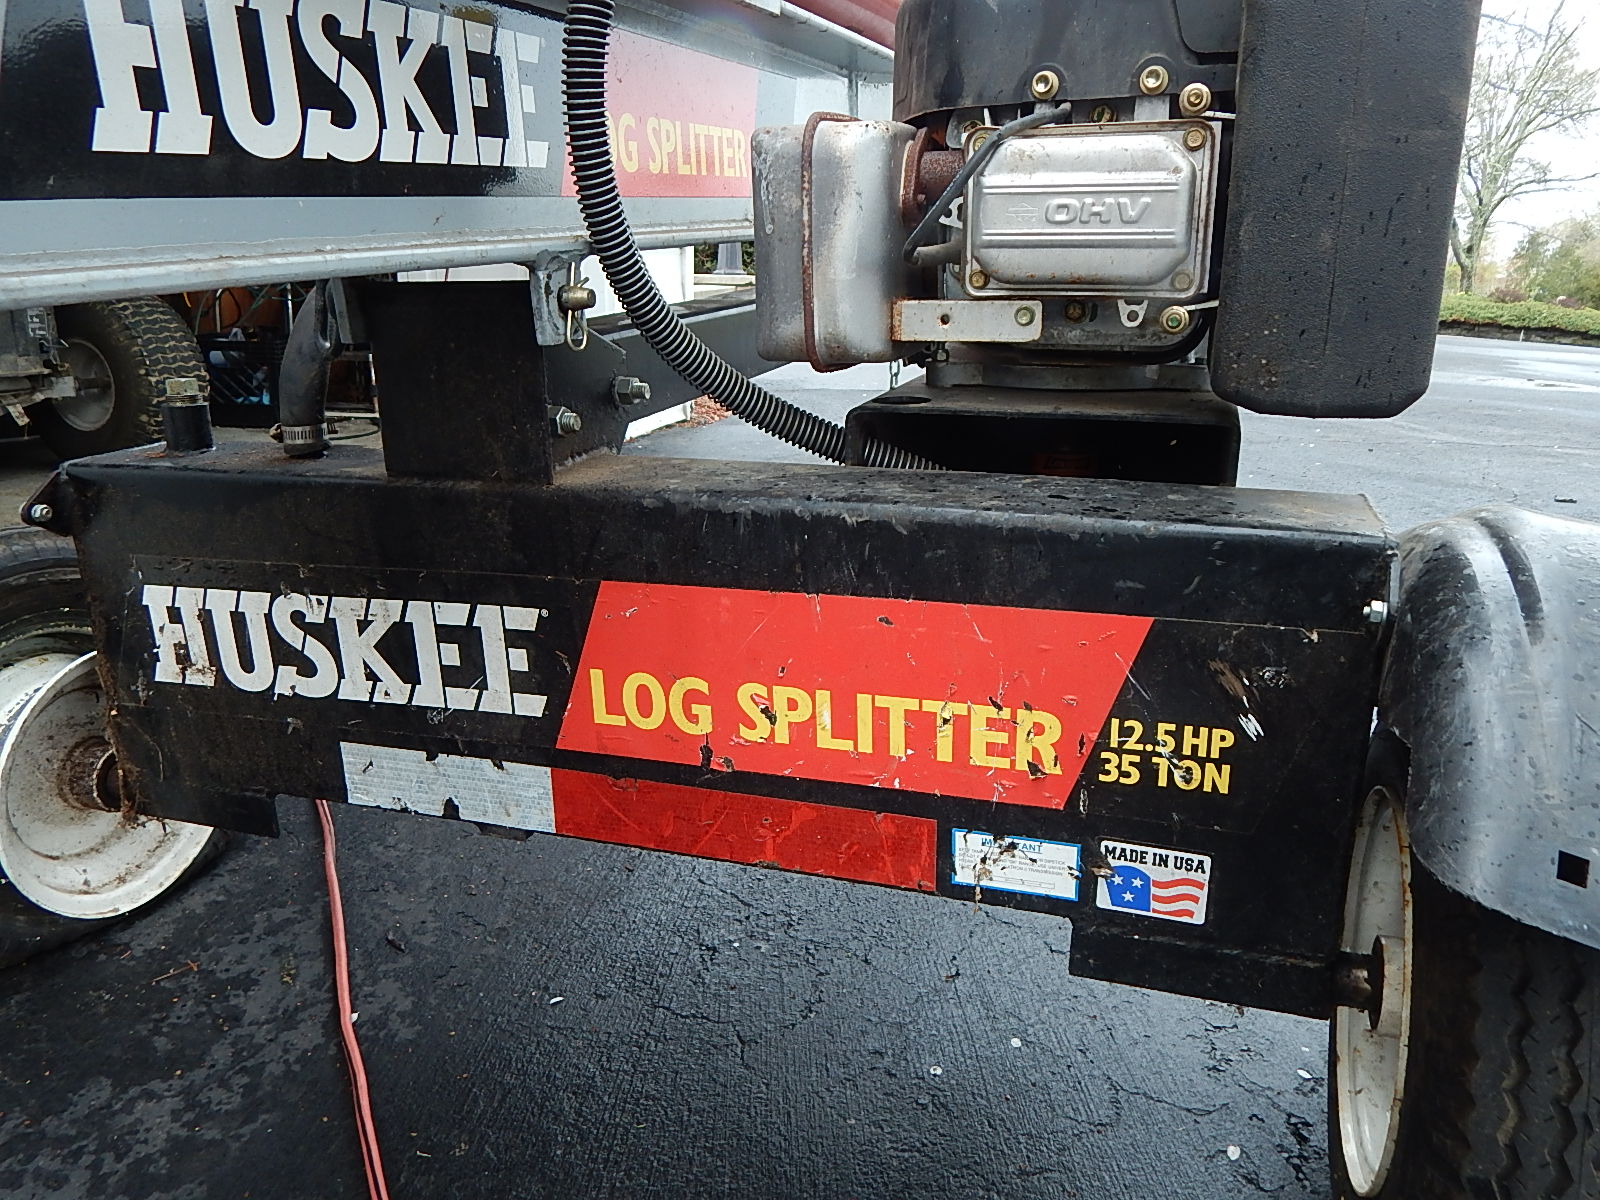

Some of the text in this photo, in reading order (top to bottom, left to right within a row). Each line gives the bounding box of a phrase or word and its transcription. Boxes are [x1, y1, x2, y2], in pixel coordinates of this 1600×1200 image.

[85, 0, 549, 168] HUSKEE
[646, 116, 748, 177] SPLITTER
[1045, 197, 1152, 225] OHV
[142, 584, 548, 717] HUSKEE
[589, 668, 1064, 775] LOG SPLITTER
[1098, 751, 1231, 795] 35 TON
[1103, 844, 1207, 875] MADE IN USA
